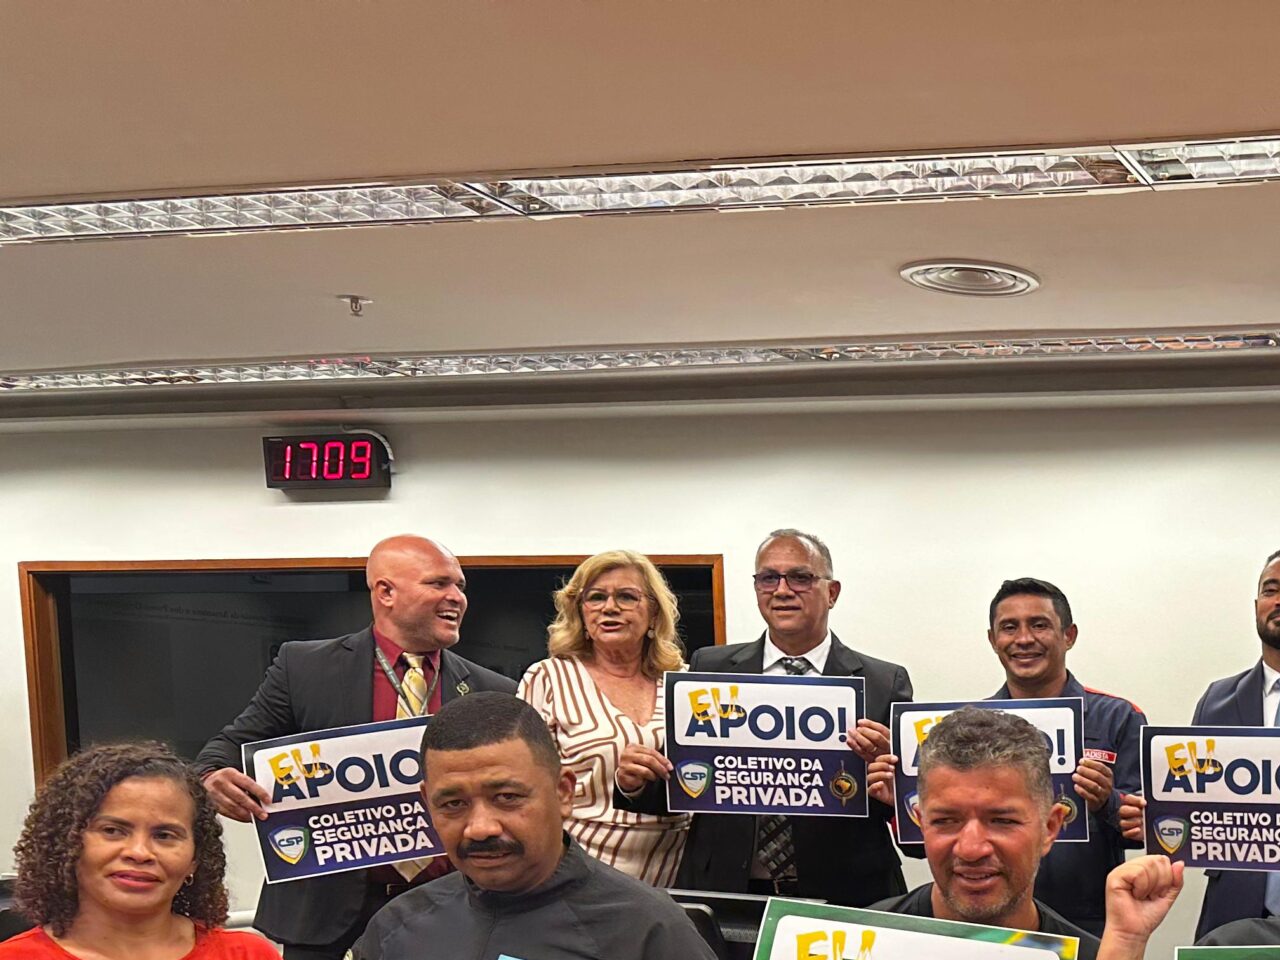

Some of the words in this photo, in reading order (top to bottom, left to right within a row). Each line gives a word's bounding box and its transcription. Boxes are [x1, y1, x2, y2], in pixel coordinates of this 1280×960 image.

[284, 441, 371, 480] 1709
[688, 685, 745, 721] EU
[685, 703, 847, 743] APOIO!
[269, 743, 331, 785] EU
[714, 756, 796, 770] COLETIVO
[801, 758, 823, 771] DA
[1165, 739, 1222, 776] EU
[714, 770, 824, 789] SEGURANÇA
[715, 786, 824, 807] PRIVADA
[308, 805, 395, 829] COLETIVO
[399, 801, 425, 816] DA
[312, 815, 429, 844] SEGURANÇA
[1190, 811, 1271, 826] COLETIVO
[278, 836, 303, 847] CSP
[314, 831, 434, 865] PRIVADA
